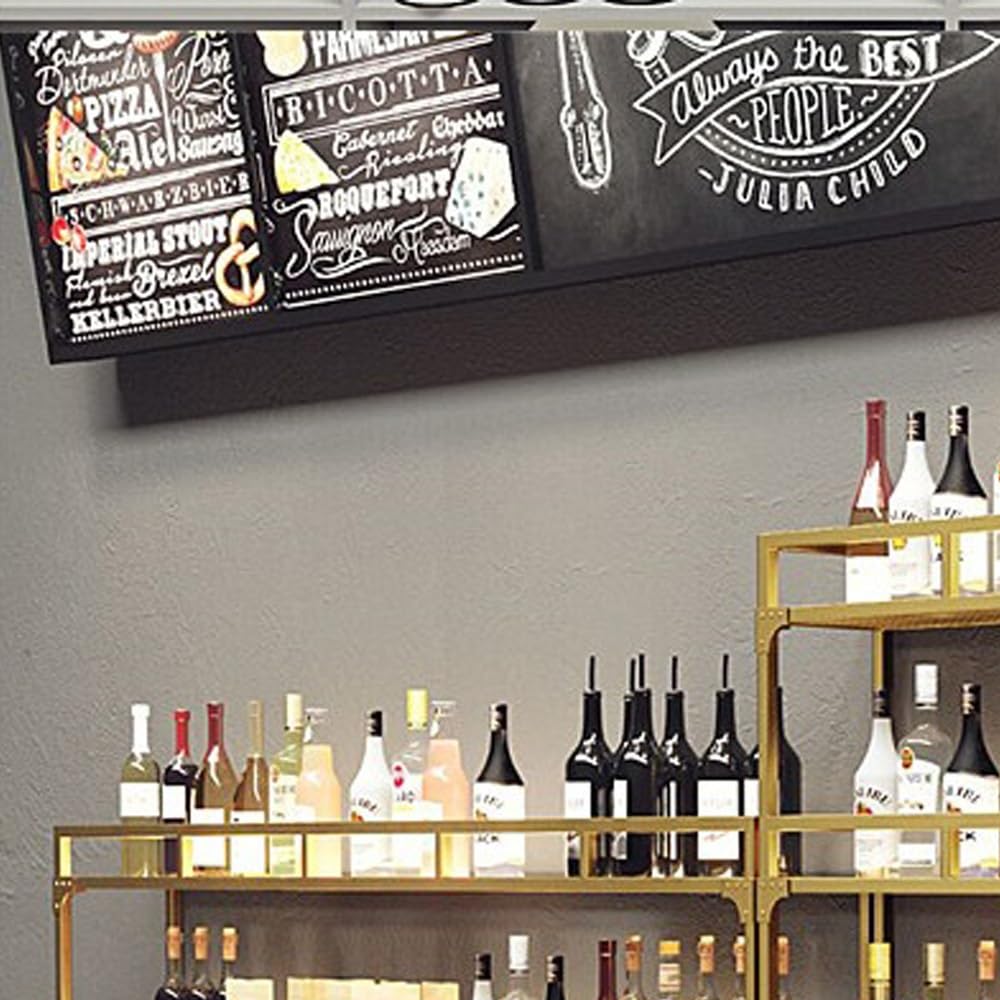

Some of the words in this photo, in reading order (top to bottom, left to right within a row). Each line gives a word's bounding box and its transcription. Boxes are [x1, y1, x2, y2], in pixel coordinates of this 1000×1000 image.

[793, 36, 848, 73] the
[858, 34, 941, 78] BEST
[84, 83, 162, 133] PIZZA
[114, 128, 168, 172] Ale
[332, 119, 419, 159] Cabernet
[317, 167, 452, 220] ROQUEFORT
[162, 213, 229, 254] STOUT
[70, 288, 222, 334] KELLERBIER
